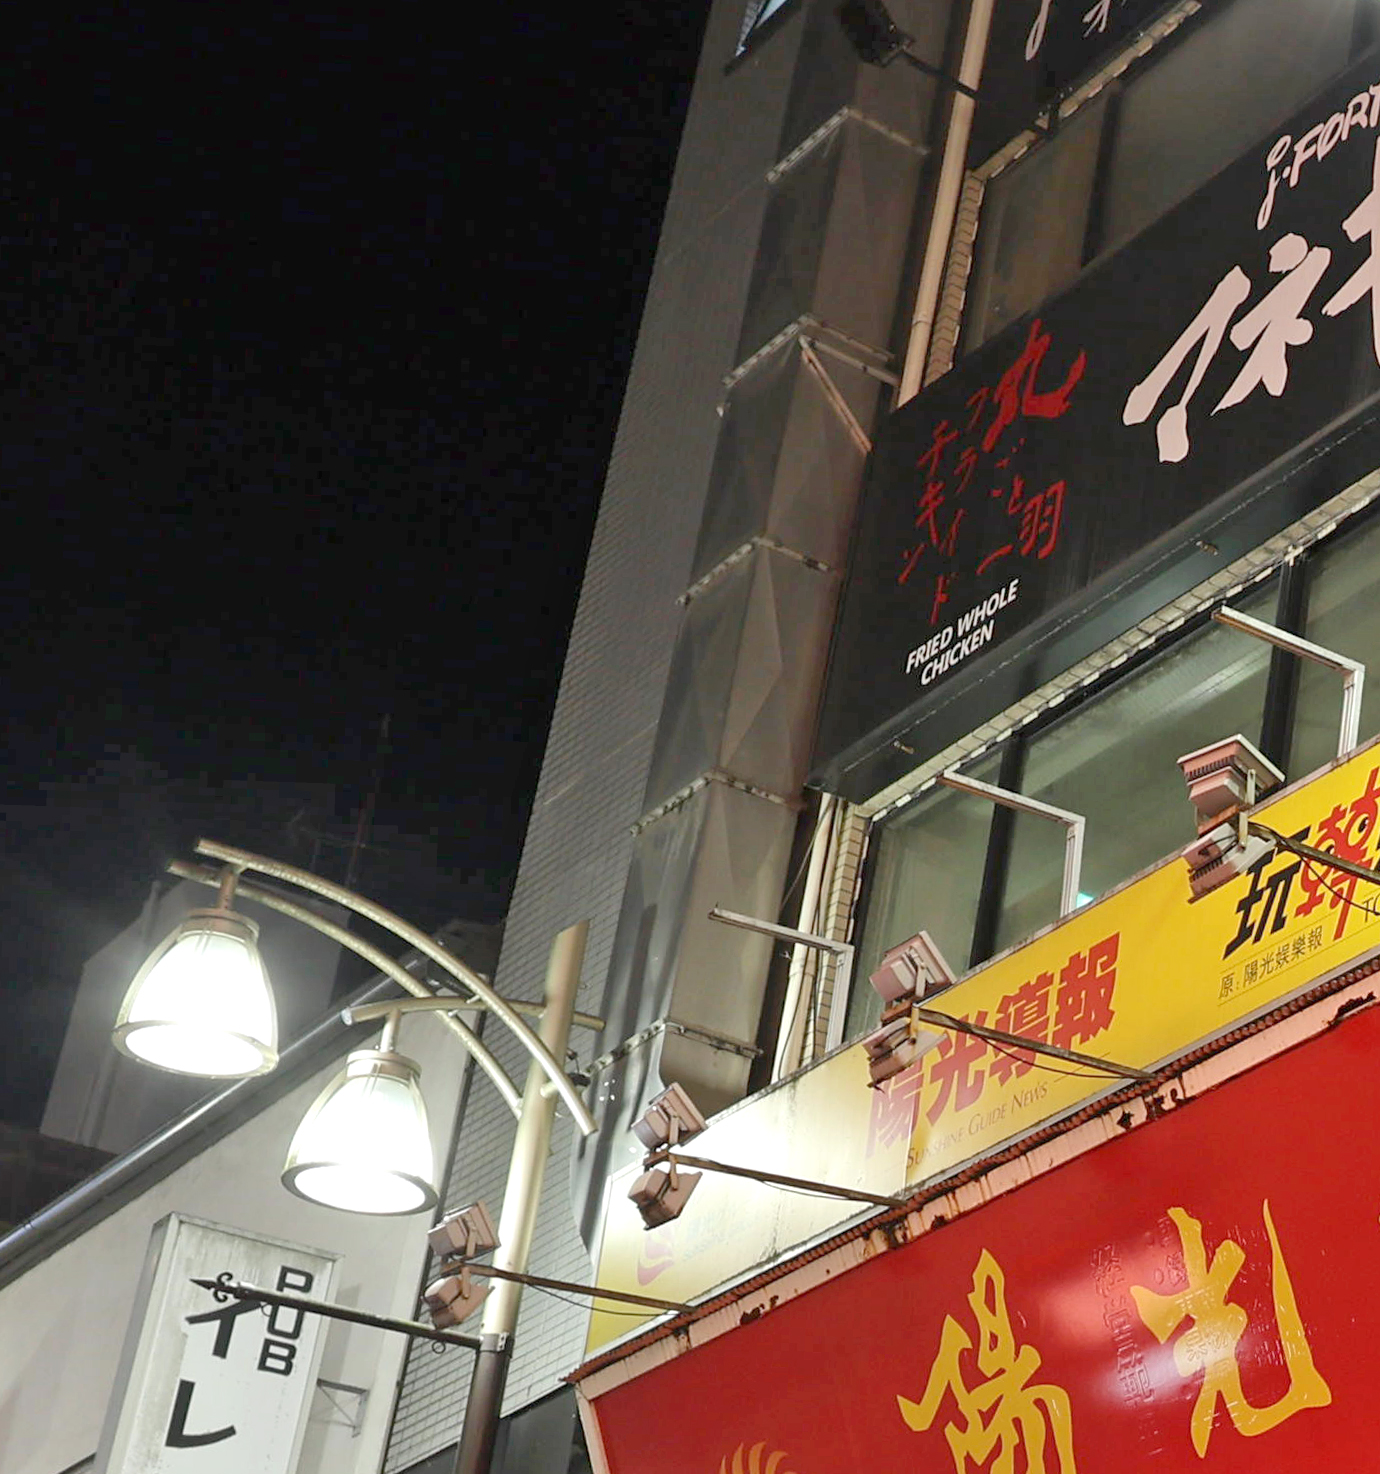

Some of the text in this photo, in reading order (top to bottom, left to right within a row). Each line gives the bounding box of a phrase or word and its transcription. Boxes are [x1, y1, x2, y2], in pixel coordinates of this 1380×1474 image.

[906, 578, 1019, 675] FRIED WHOLE
[920, 618, 995, 686] CHICKEN
[967, 1104, 1009, 1138] GUIDE
[1010, 1080, 1050, 1114] NEWS
[256, 1265, 315, 1377] PUB
